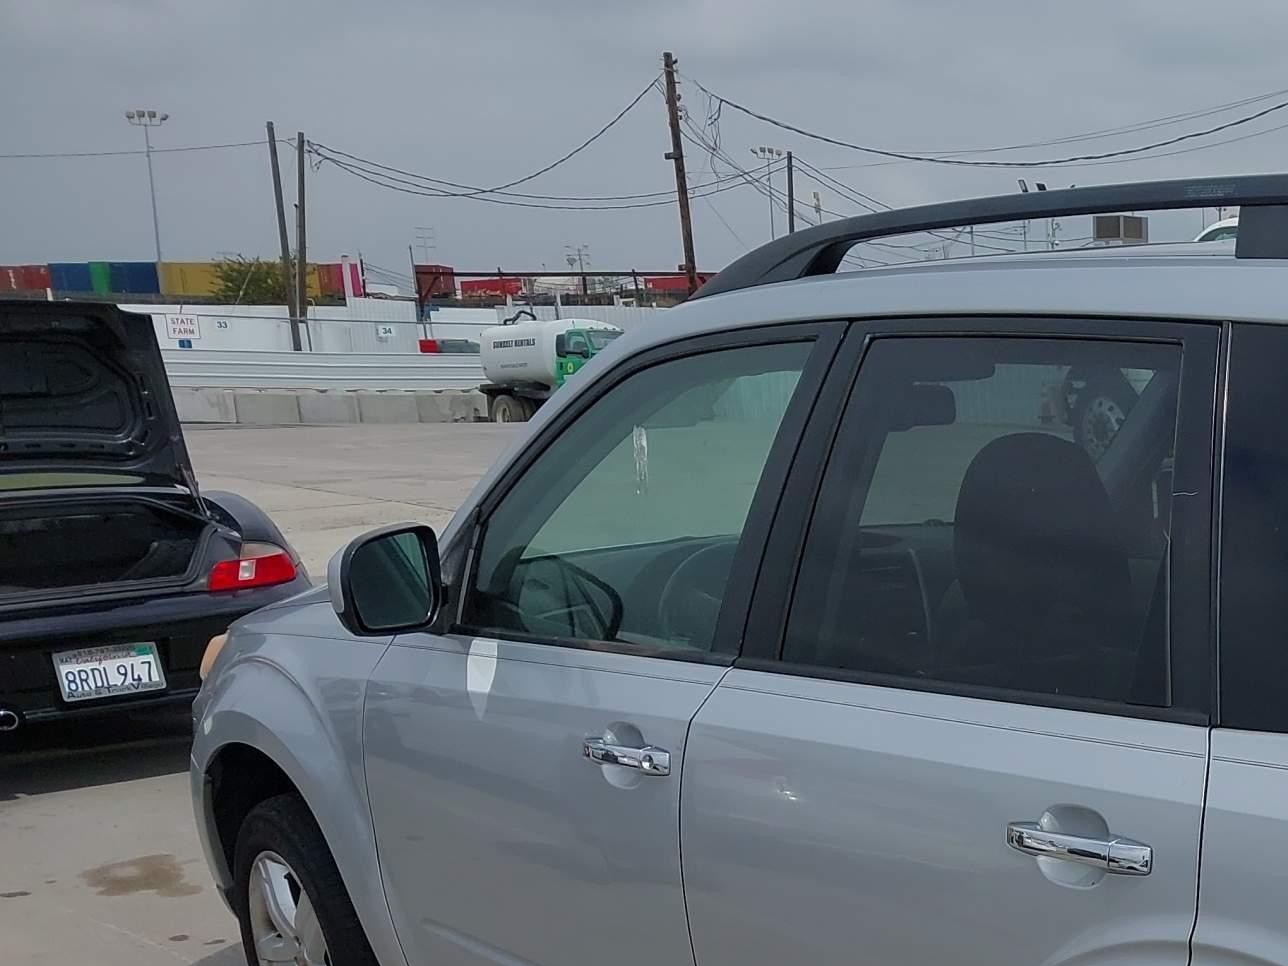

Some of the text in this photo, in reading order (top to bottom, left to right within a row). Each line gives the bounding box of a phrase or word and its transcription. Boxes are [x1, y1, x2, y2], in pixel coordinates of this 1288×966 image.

[170, 317, 195, 325] STATE
[216, 321, 228, 329] 33
[172, 327, 195, 335] FARM
[382, 327, 393, 335] 34
[515, 338, 535, 347] RENTALS
[64, 661, 153, 692] 8RDL947
